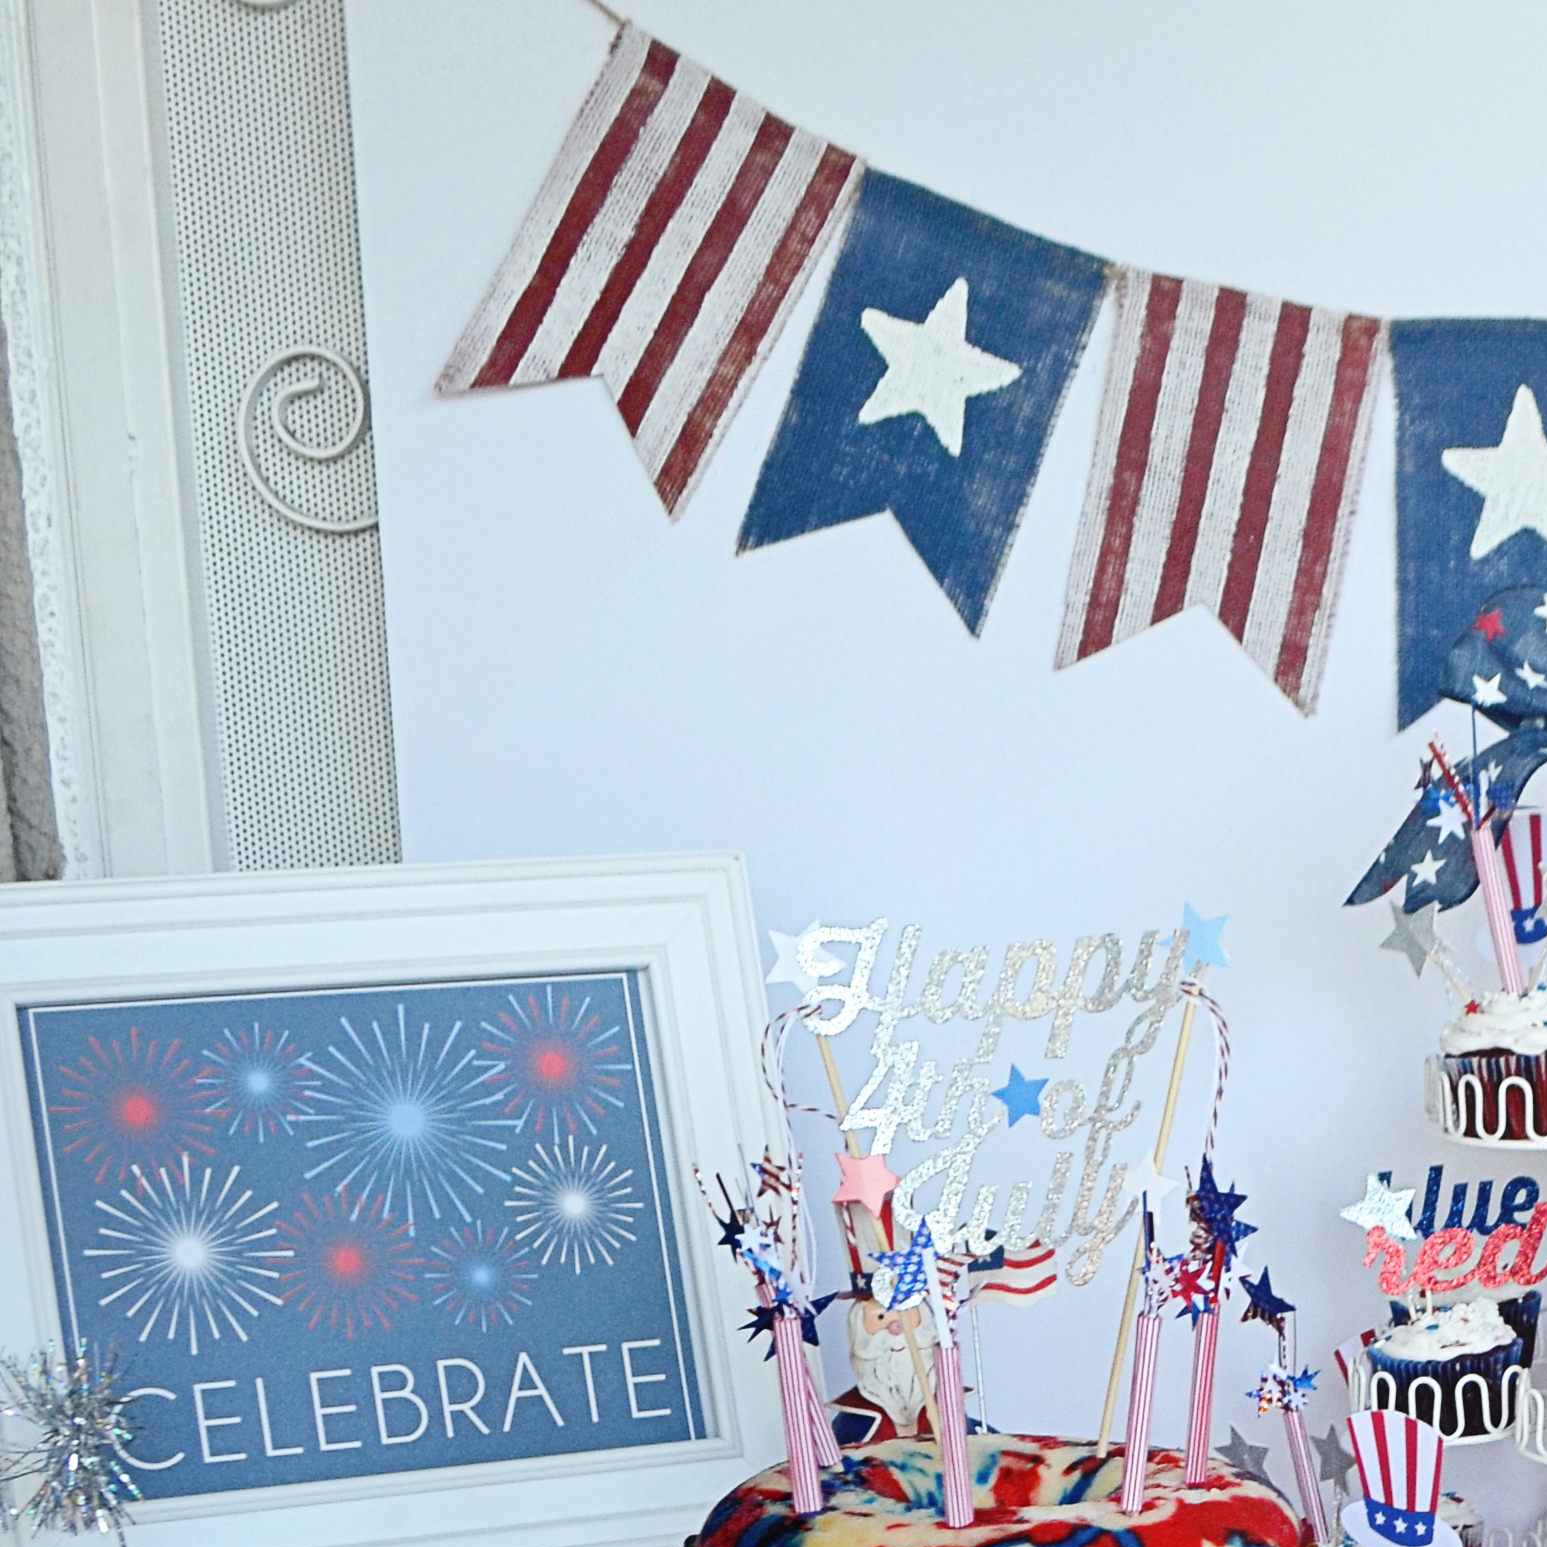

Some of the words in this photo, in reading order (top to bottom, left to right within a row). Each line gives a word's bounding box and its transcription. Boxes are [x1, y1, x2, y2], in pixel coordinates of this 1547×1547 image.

[796, 917, 1191, 1060] Happy
[839, 1040, 1000, 1156] 4th
[1040, 1038, 1142, 1162] of
[871, 1138, 1139, 1312] July
[1377, 1164, 1540, 1240] lue
[107, 1339, 673, 1471] CELEBRATE
